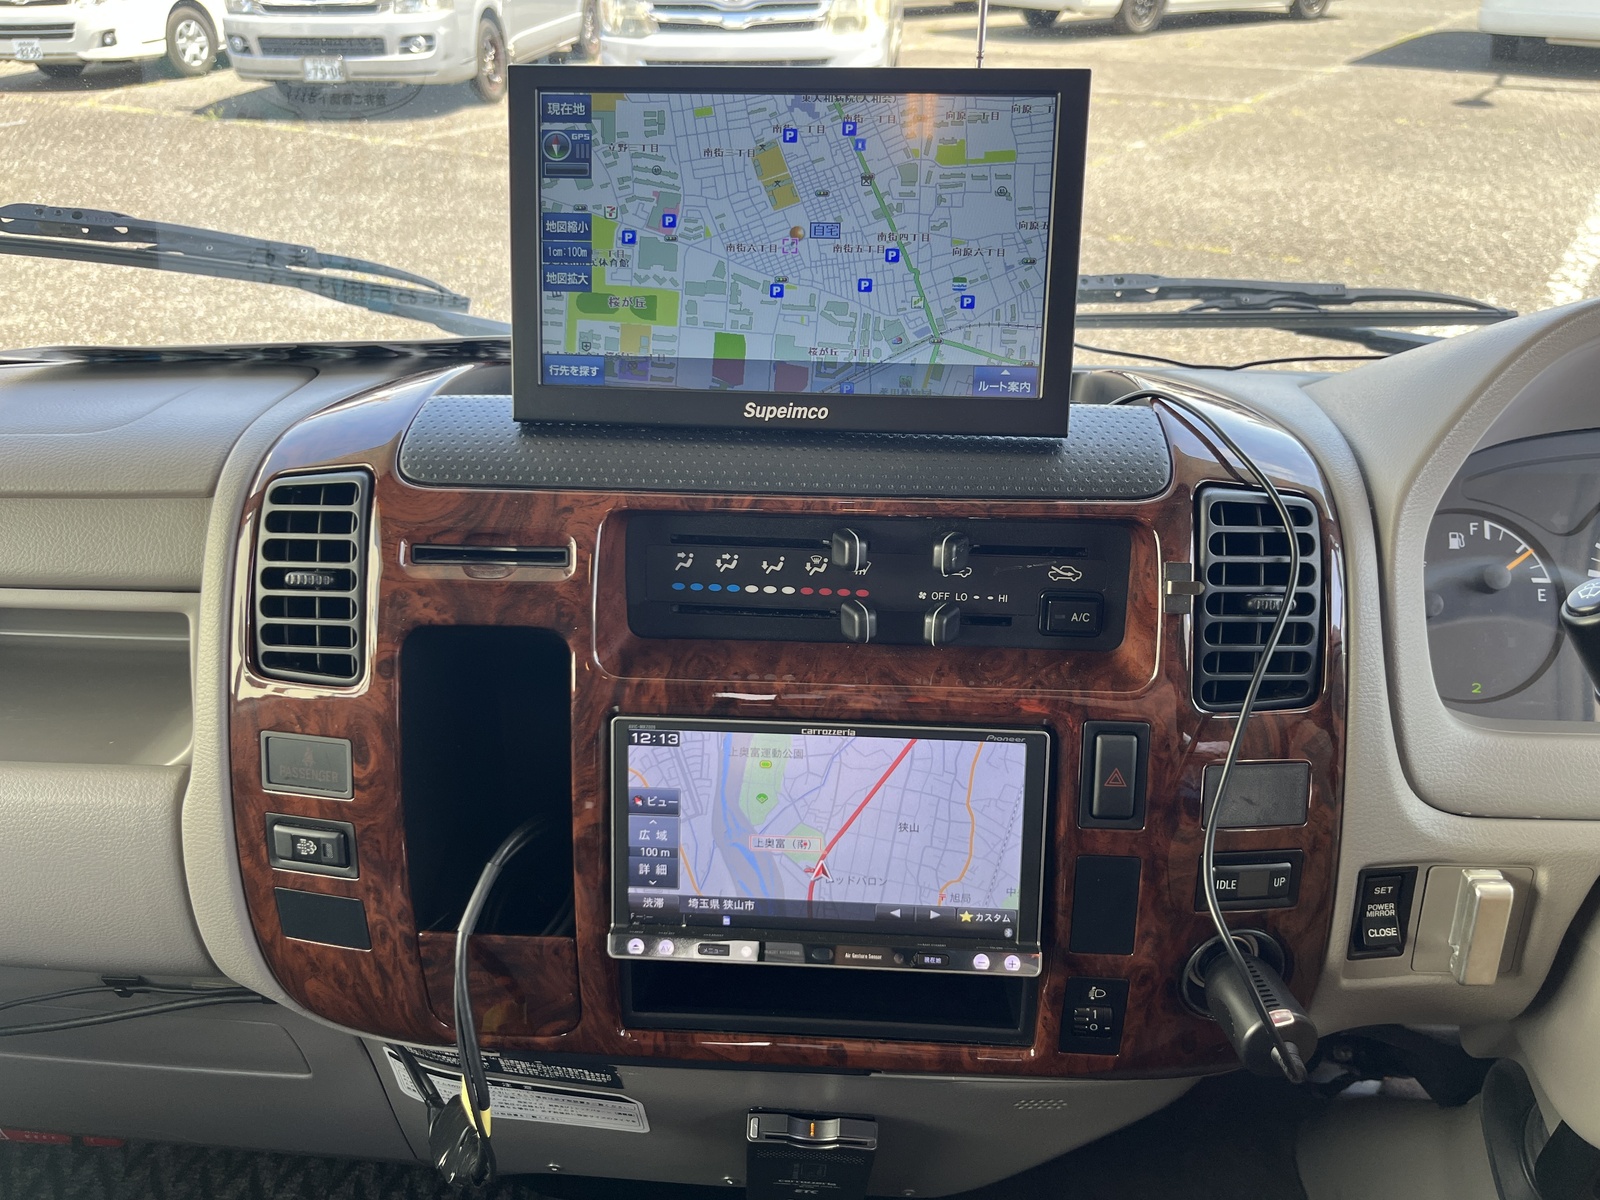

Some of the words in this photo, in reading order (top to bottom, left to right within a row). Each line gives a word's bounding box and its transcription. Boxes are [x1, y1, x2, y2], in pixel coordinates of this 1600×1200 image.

[547, 102, 586, 116] 現在地
[571, 133, 590, 141] GPS
[545, 220, 589, 233] 地図縮小
[813, 224, 839, 237] 自宅
[877, 232, 930, 242] 南街四丁目
[547, 246, 588, 257] 1cm:100m
[726, 243, 778, 253] 南街六丁目
[952, 247, 1006, 257] 向原六丁目
[546, 272, 589, 285] 地図拡大
[608, 296, 648, 309] 桜が丘
[549, 365, 600, 377] 行先を探す
[978, 381, 1031, 393] ルート案内
[743, 402, 829, 421] Supeimco
[1469, 522, 1479, 535] F
[931, 592, 950, 600] OFF
[955, 593, 968, 602] LO
[998, 594, 1008, 603] HI
[1537, 588, 1547, 602] E
[1071, 613, 1091, 622] A/C
[1471, 682, 1482, 694] 2
[801, 728, 856, 737] carrozzeria
[631, 732, 679, 745] 12:13
[985, 734, 1026, 743] Pioneer
[279, 765, 339, 783] PASSENGER
[647, 796, 679, 807] ビュー
[898, 822, 920, 833] 狭山
[1216, 879, 1237, 890] IDLE
[1273, 876, 1286, 887] UP
[1373, 886, 1393, 894] SET
[642, 897, 665, 909] 渋滞
[688, 897, 720, 909] 埼玉県
[722, 899, 755, 911] 狭山市
[1367, 903, 1395, 911] POWER
[975, 912, 1011, 923] カスタム
[1366, 909, 1395, 918] MIRROR
[1368, 927, 1397, 937] CLOSE
